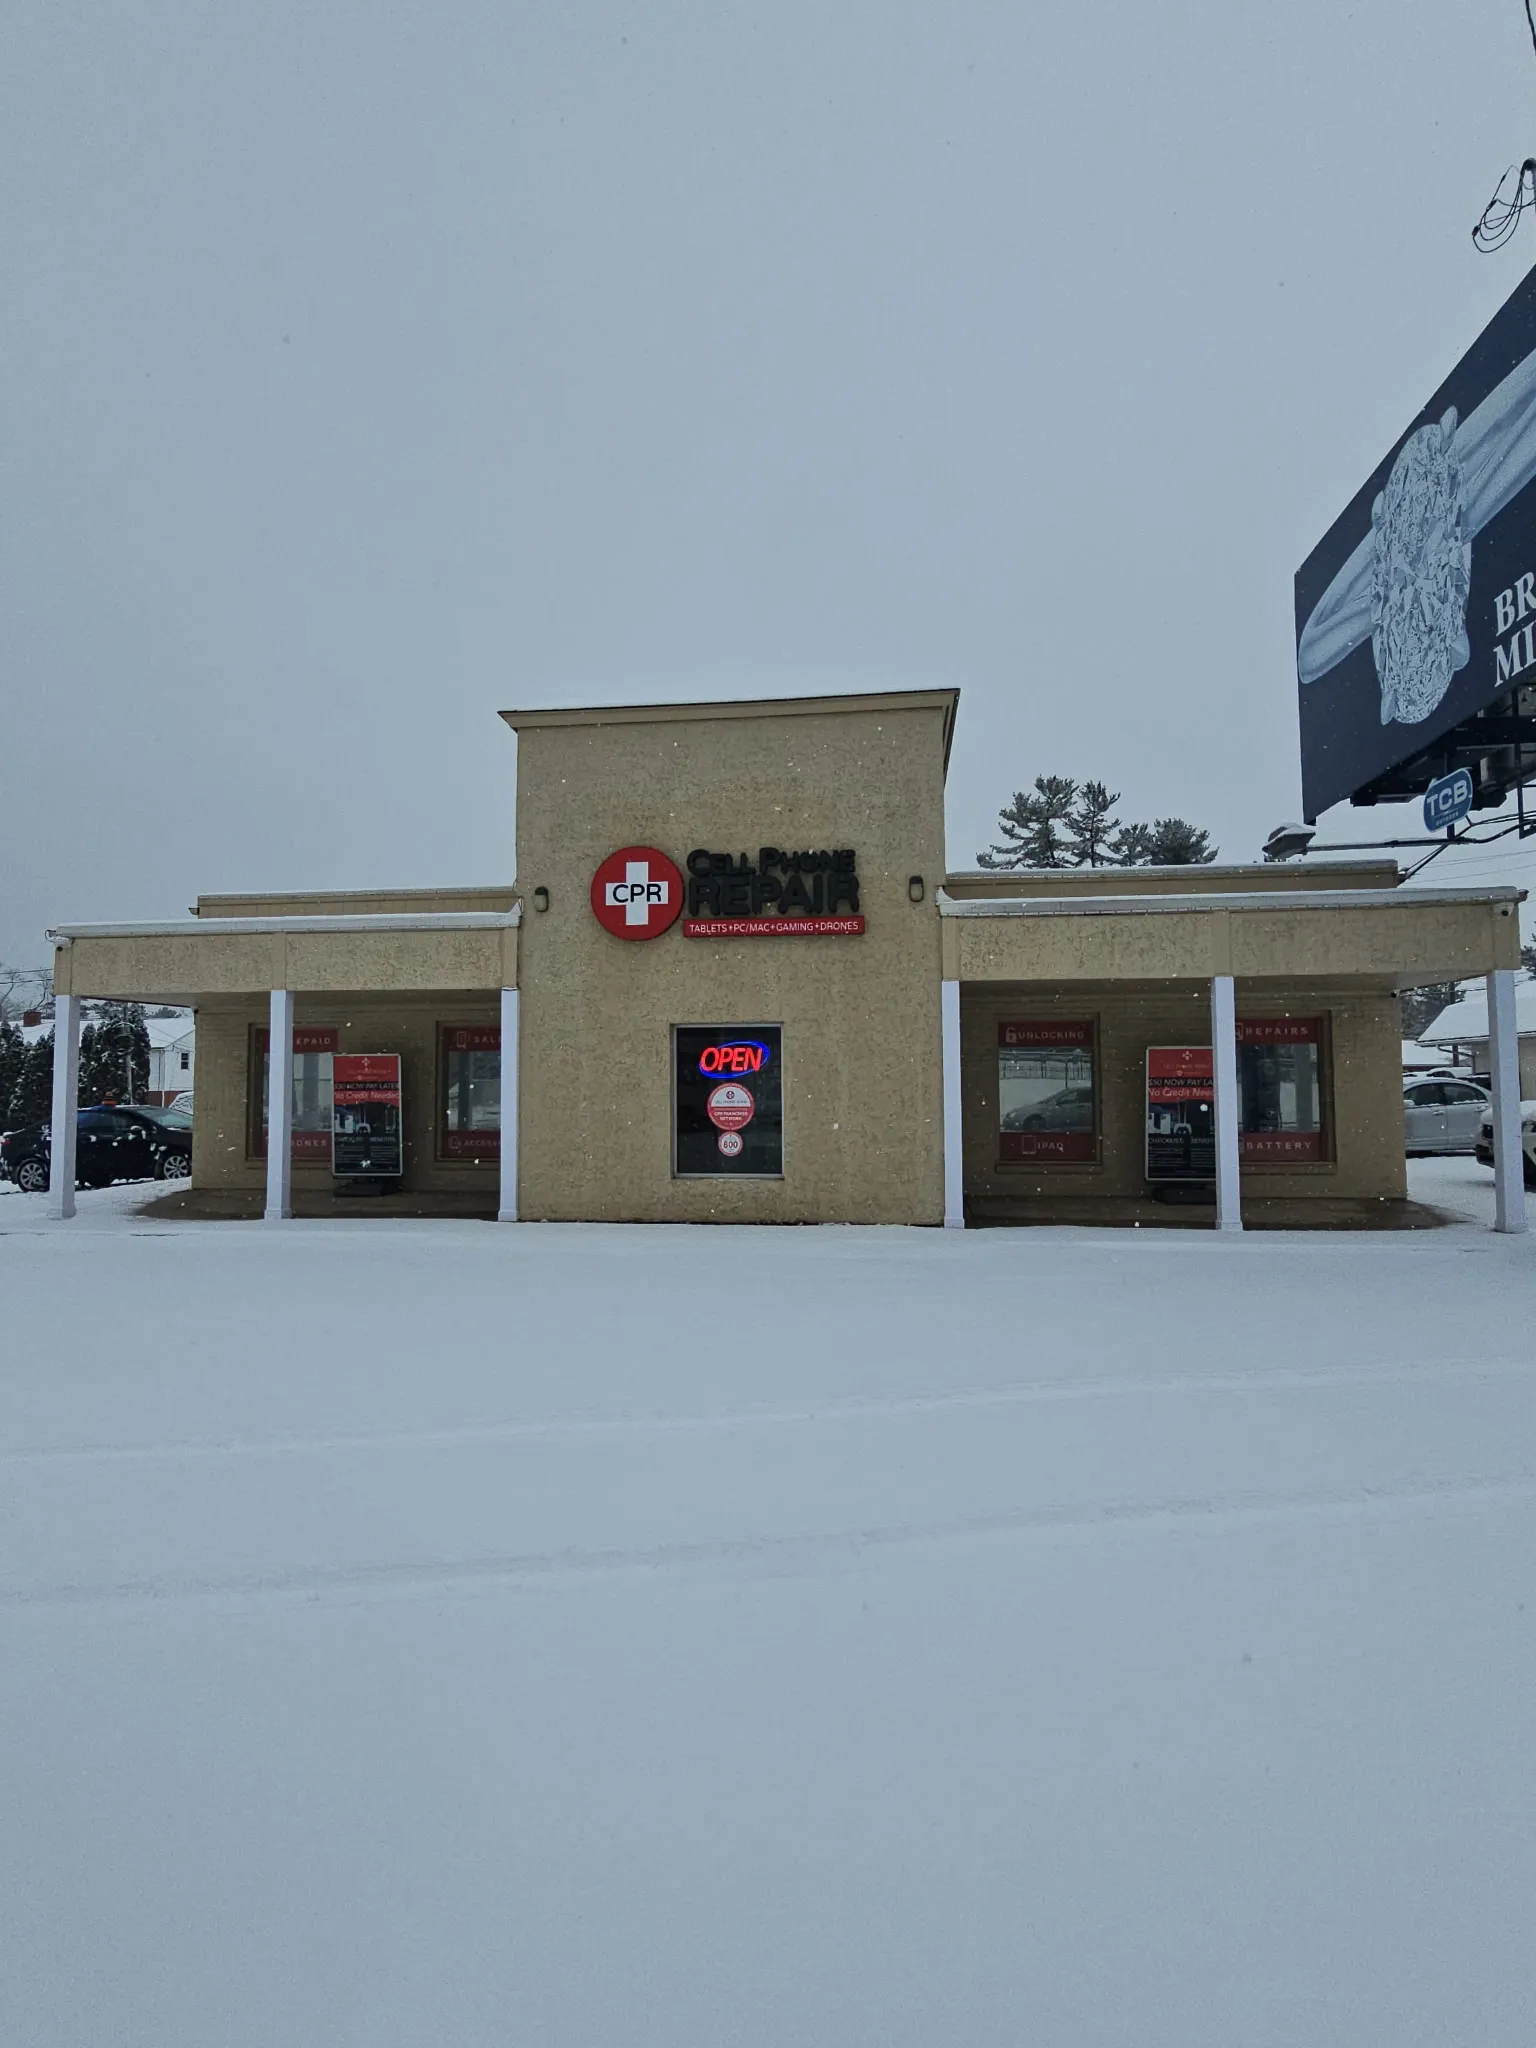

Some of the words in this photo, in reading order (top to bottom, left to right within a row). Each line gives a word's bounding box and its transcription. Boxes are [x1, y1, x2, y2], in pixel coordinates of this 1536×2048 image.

[1427, 780, 1468, 816] TCB
[613, 883, 661, 903] CPR
[689, 874, 860, 916] REPAIR
[689, 924, 728, 933] TABLETS
[733, 923, 770, 933] PC/MAC
[776, 922, 813, 932] GAMING
[820, 921, 858, 931] DRONES
[1018, 1031, 1085, 1039] UNLOCKING
[1245, 1027, 1308, 1036] REPAIRS
[295, 1037, 331, 1045] EPAID
[473, 1035, 501, 1044] SAL
[700, 1047, 763, 1072] OPEN
[1164, 1078, 1185, 1086] NOW
[1187, 1078, 1201, 1086] PAY
[1162, 1087, 1190, 1097] Credit
[723, 1140, 738, 1149] 600
[1246, 1141, 1312, 1150] BATTERY
